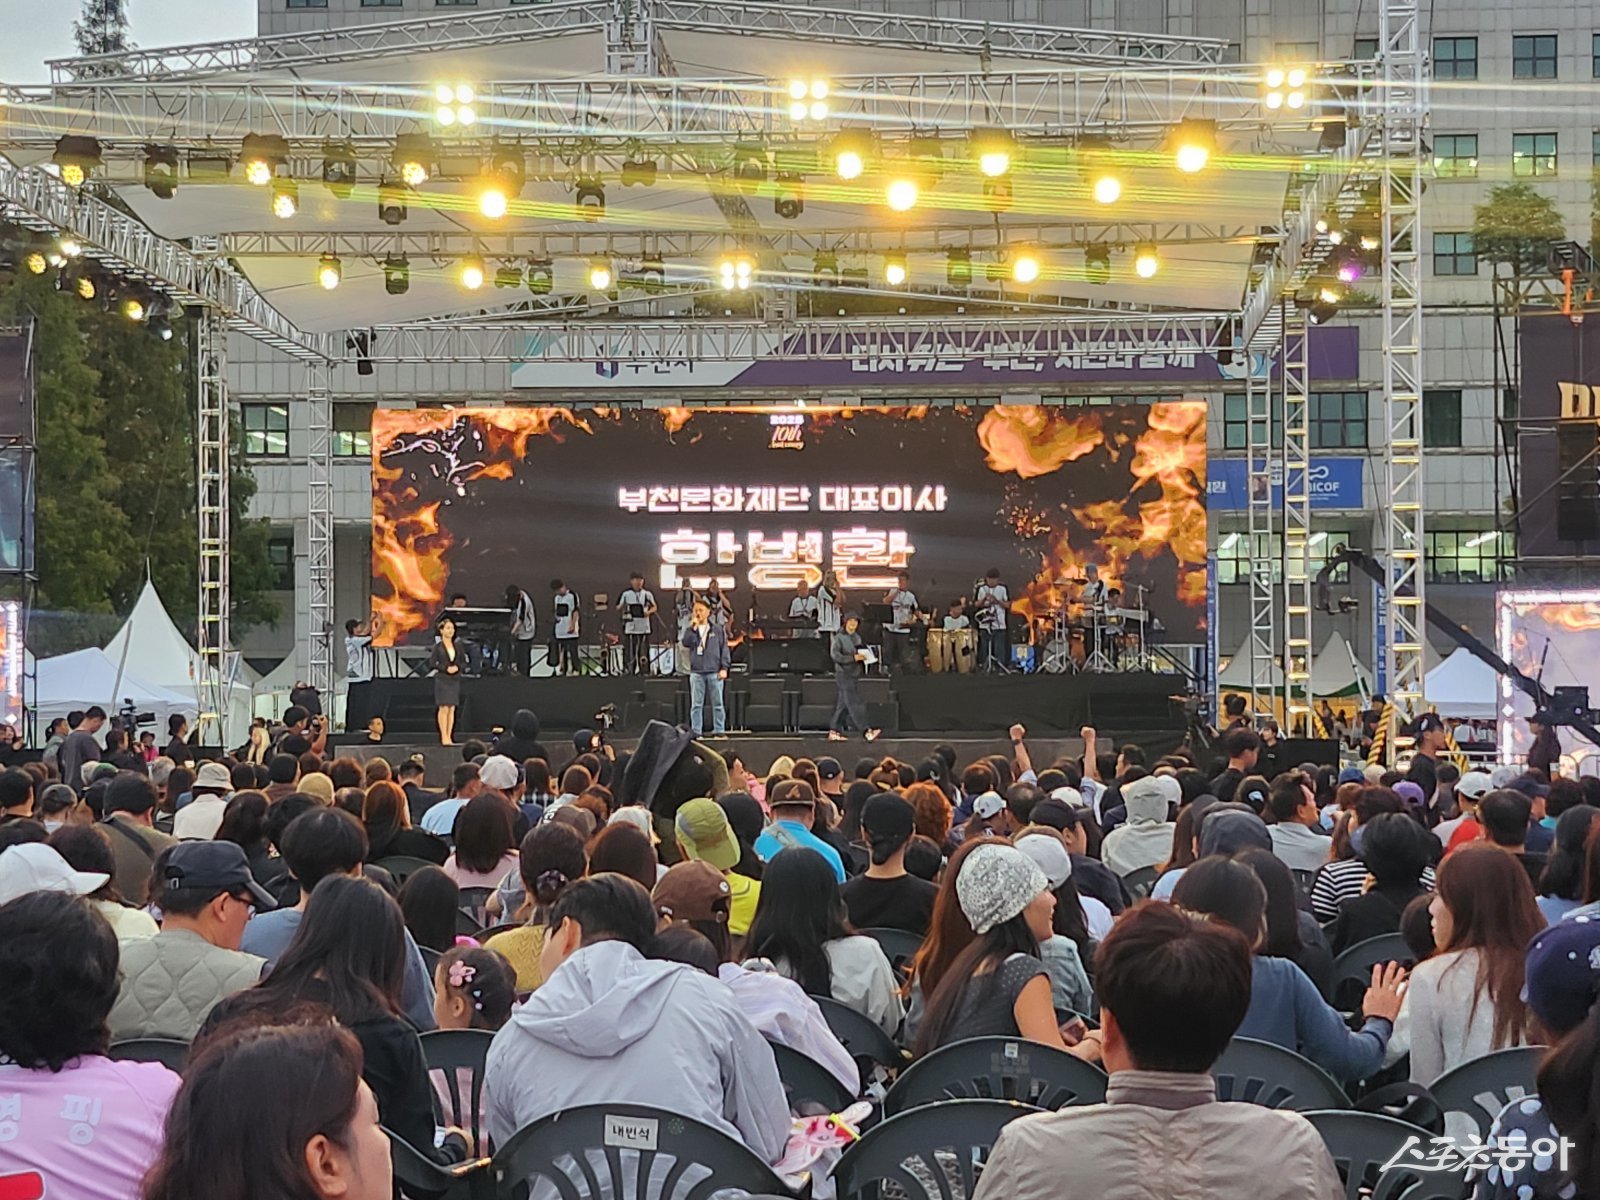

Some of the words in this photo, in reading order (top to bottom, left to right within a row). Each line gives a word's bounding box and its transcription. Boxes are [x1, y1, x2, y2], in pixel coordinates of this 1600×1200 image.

[619, 486, 811, 512] 부천문화재단
[819, 485, 948, 512] 대표이사
[659, 527, 916, 589] 한병환
[612, 1124, 650, 1142] 내빈석
